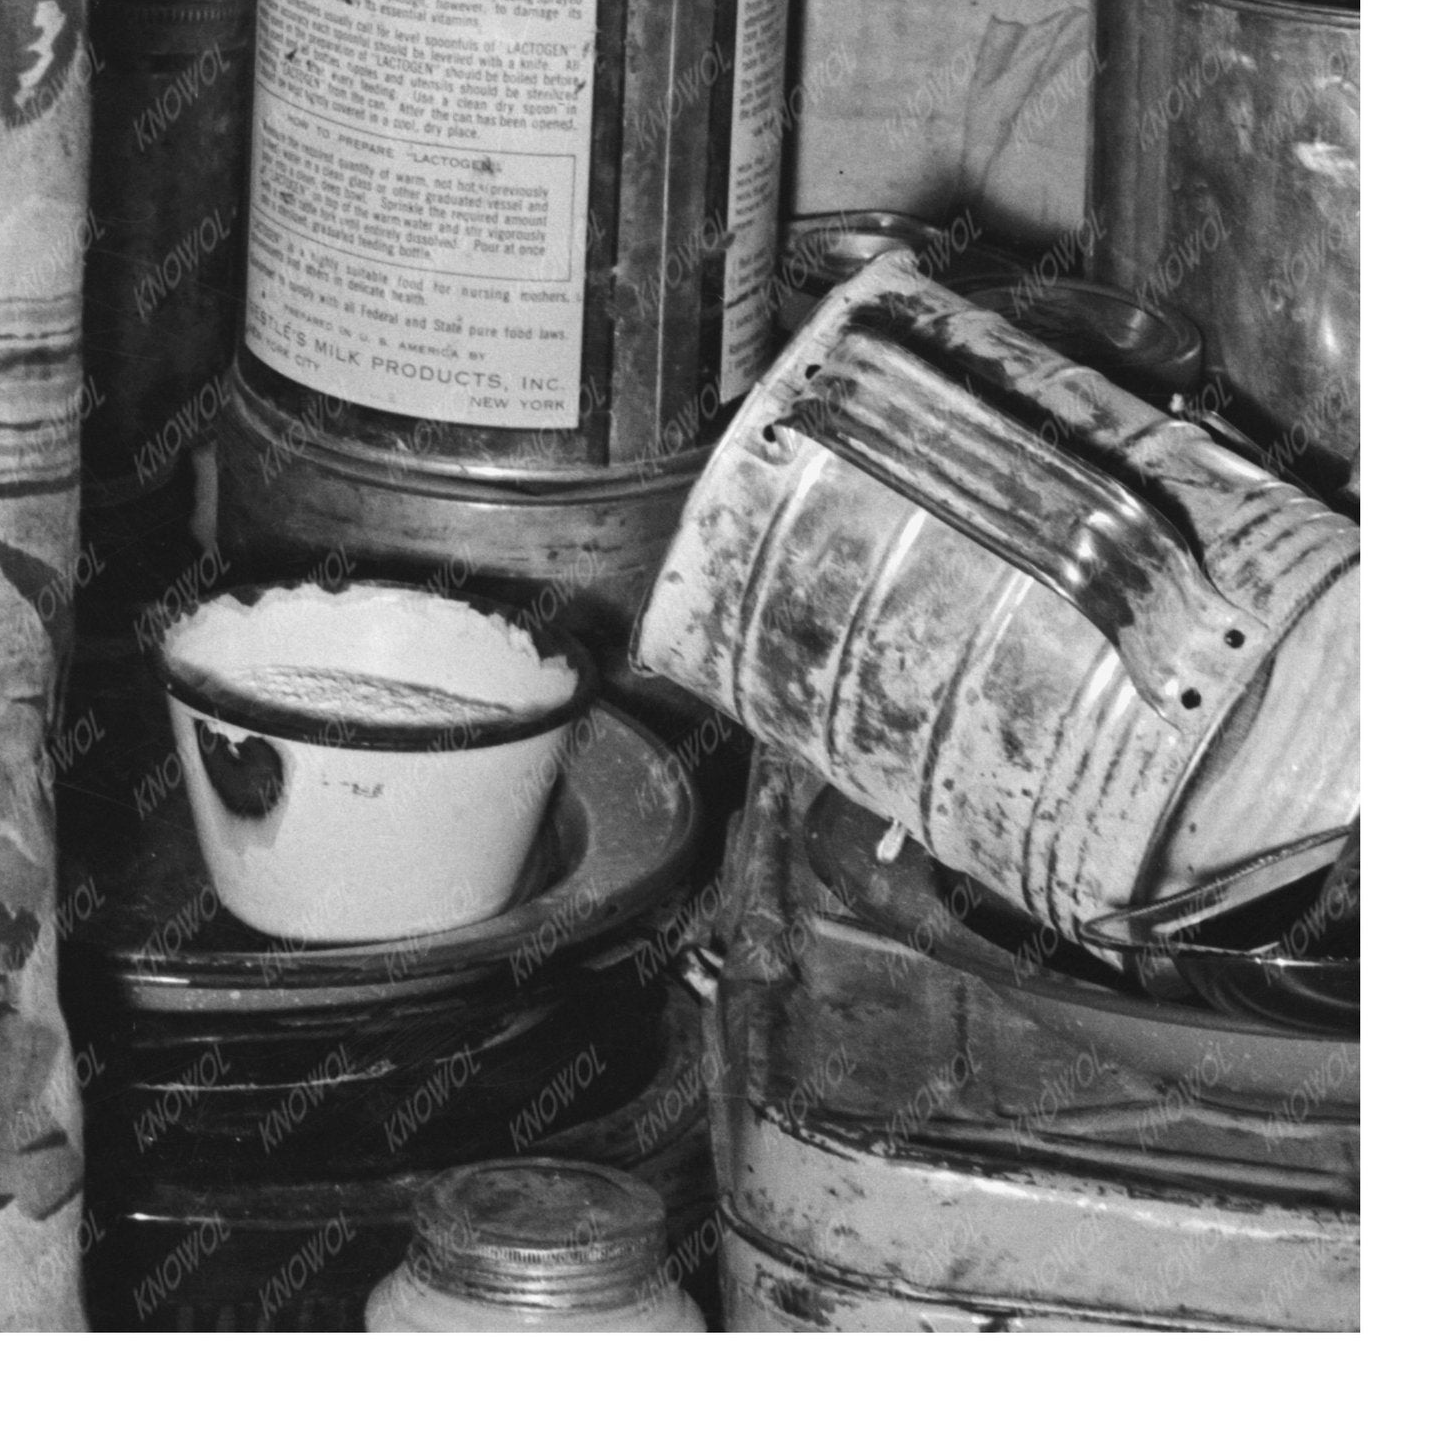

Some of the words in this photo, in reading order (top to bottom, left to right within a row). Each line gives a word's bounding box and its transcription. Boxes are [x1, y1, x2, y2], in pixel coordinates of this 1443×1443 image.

[314, 337, 361, 367] MILK
[370, 355, 511, 394] PRODUCTS,
[469, 395, 510, 410] NEW
[519, 397, 566, 412] YORK
